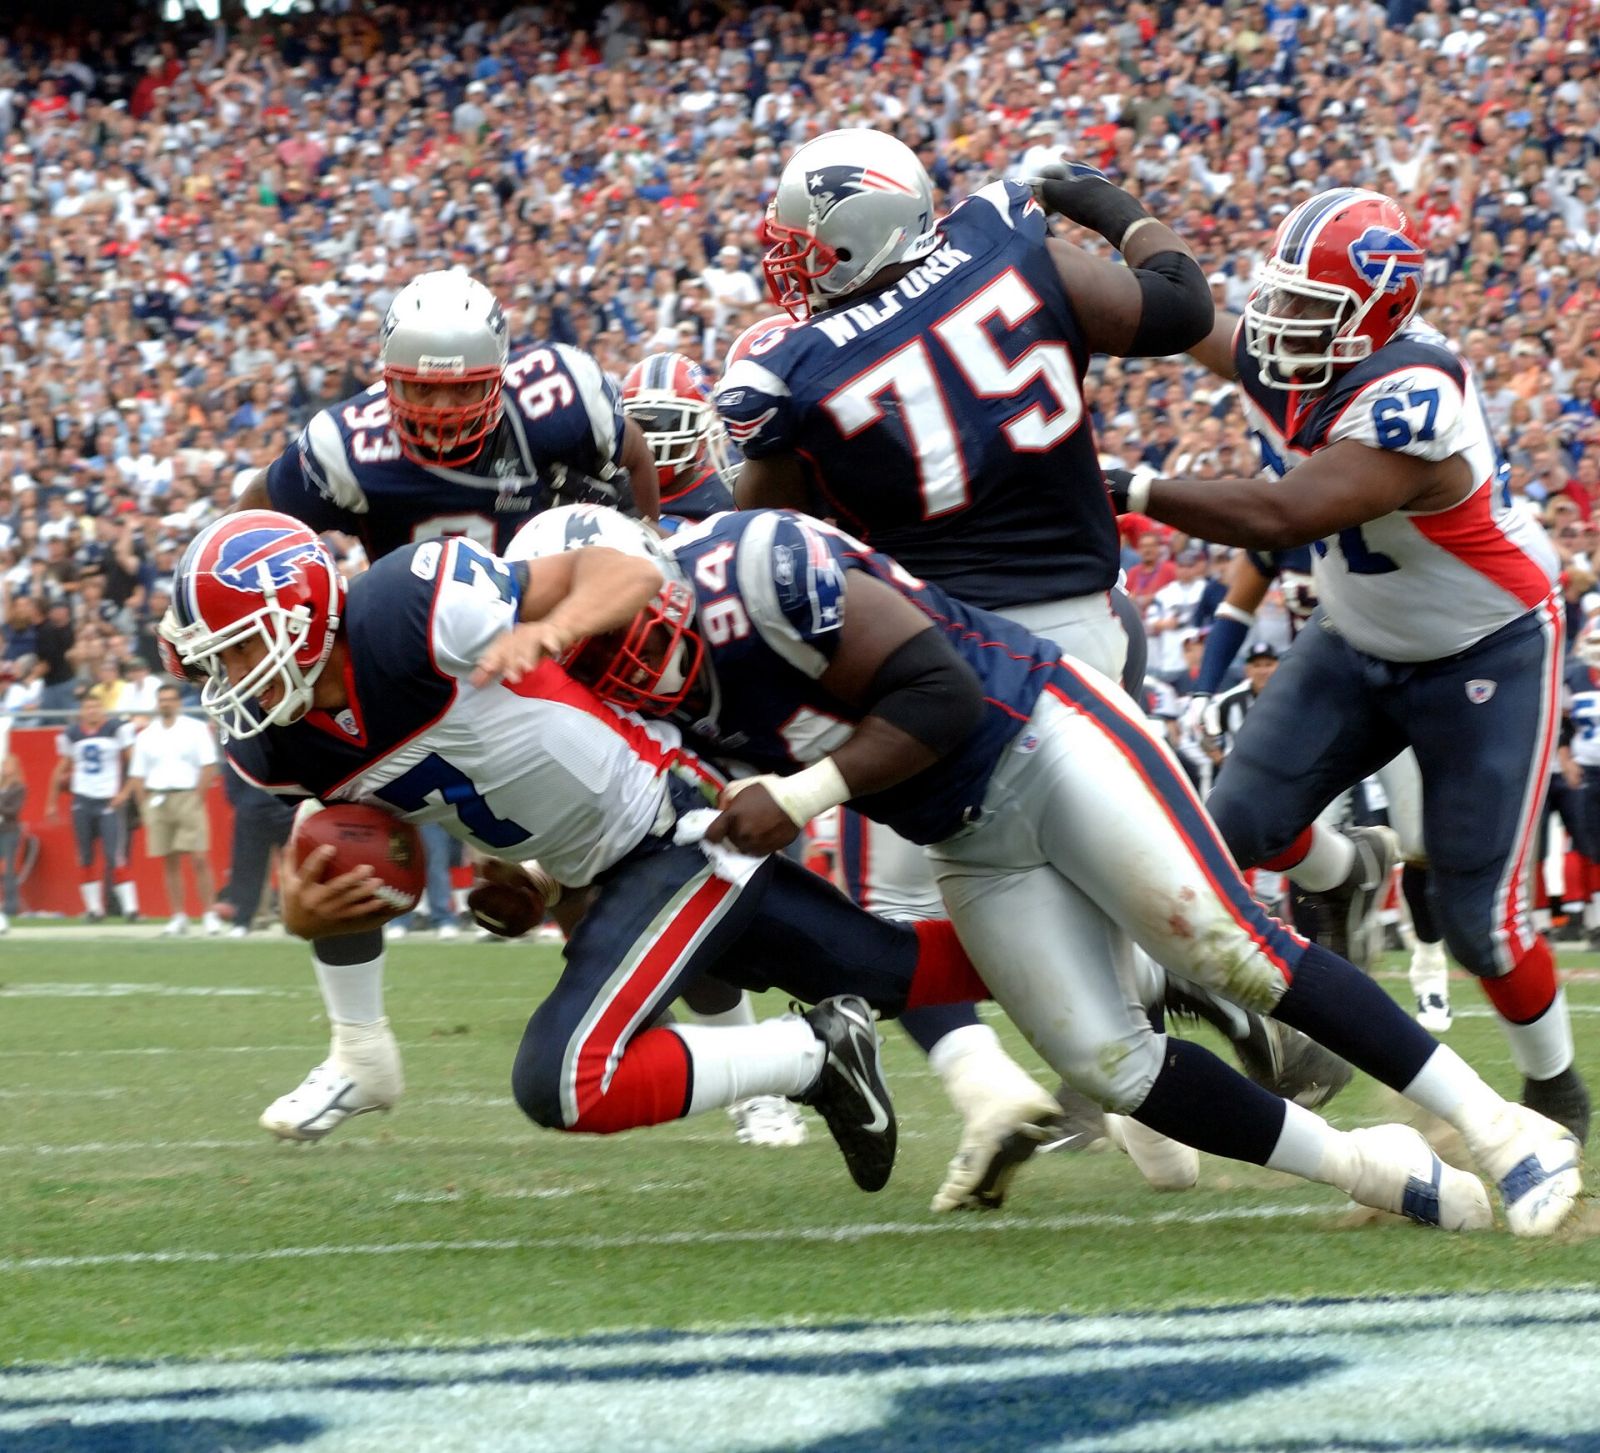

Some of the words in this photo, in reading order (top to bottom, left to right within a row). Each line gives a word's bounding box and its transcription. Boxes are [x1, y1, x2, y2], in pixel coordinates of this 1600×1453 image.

[918, 211, 928, 235] 7
[502, 347, 575, 422] 93
[820, 265, 1086, 521] 75
[1372, 387, 1440, 449] 67
[452, 541, 513, 606] 7
[694, 539, 751, 648] 94
[83, 745, 102, 774] 9
[373, 751, 534, 849] 7
